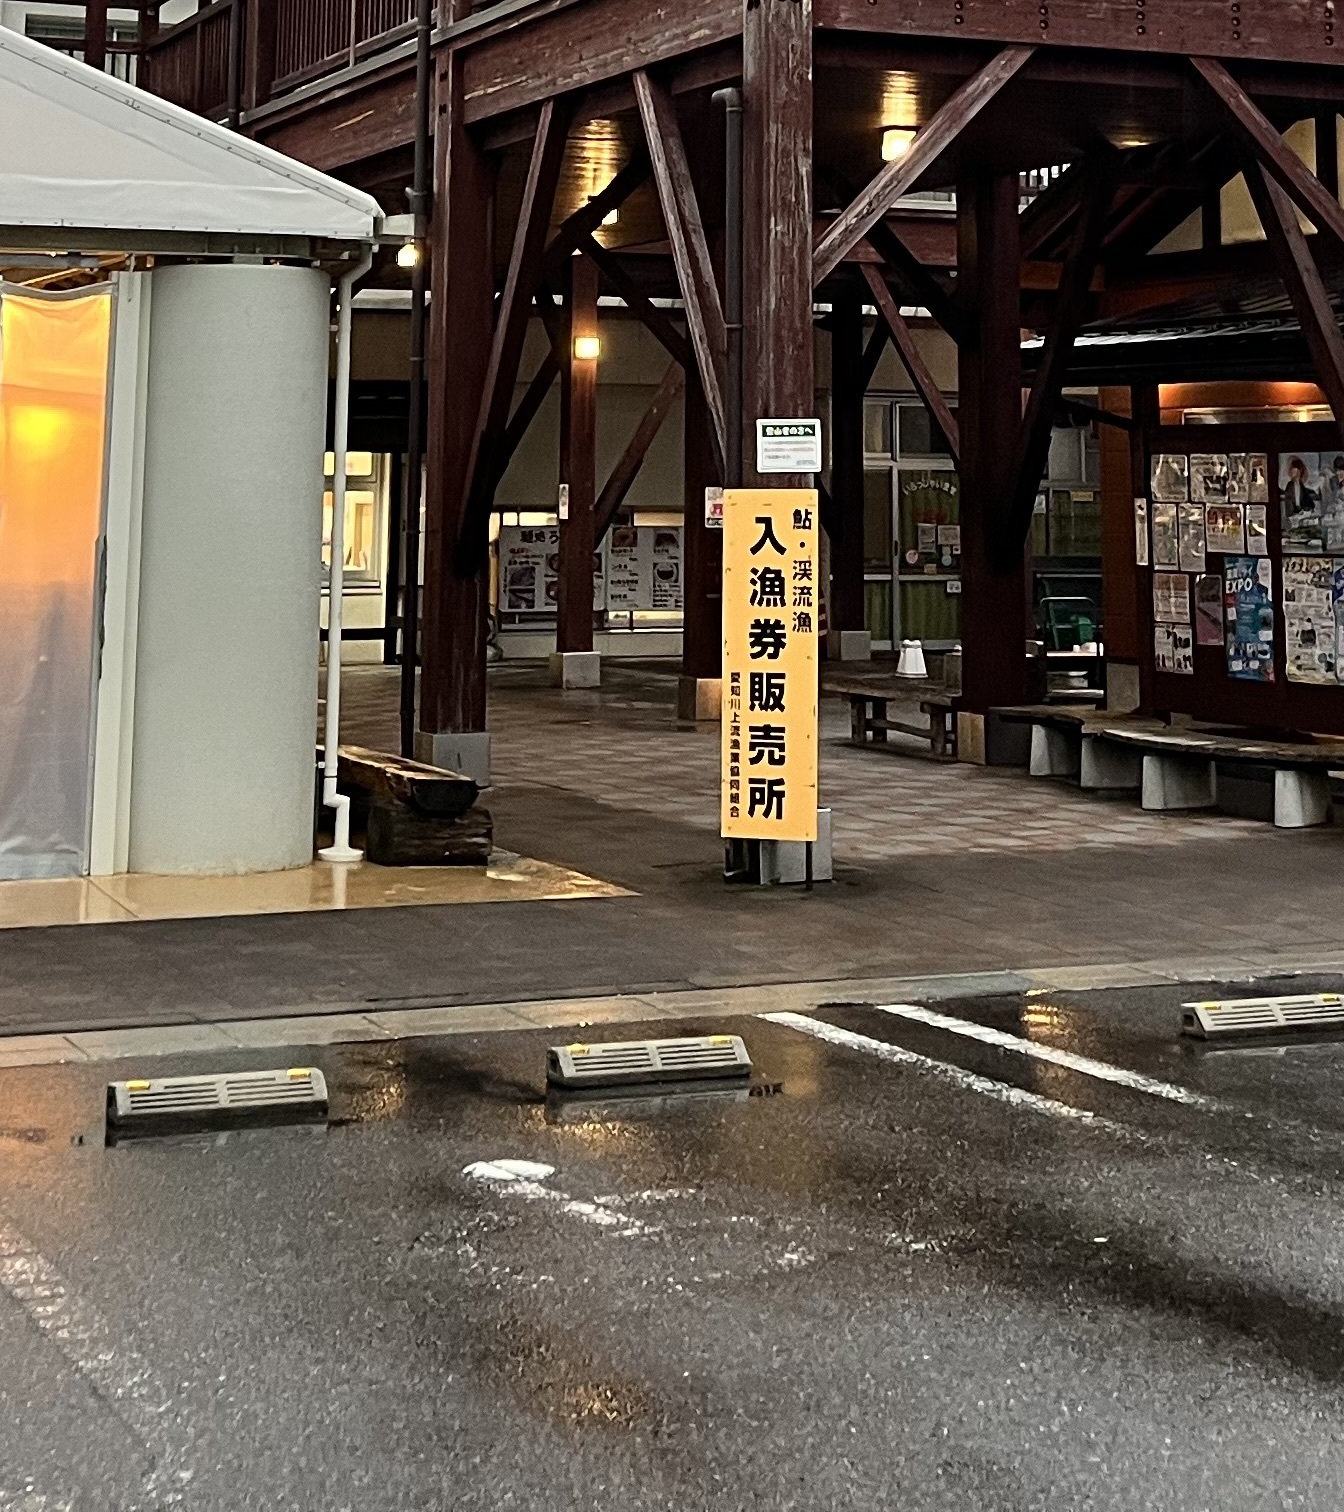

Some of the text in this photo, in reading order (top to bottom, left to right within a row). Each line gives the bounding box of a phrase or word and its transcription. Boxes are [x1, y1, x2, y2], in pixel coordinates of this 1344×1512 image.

[792, 508, 813, 633] 鮎・渓流漁
[1225, 577, 1253, 594] EXPO
[747, 516, 788, 820] 入漁券販売所
